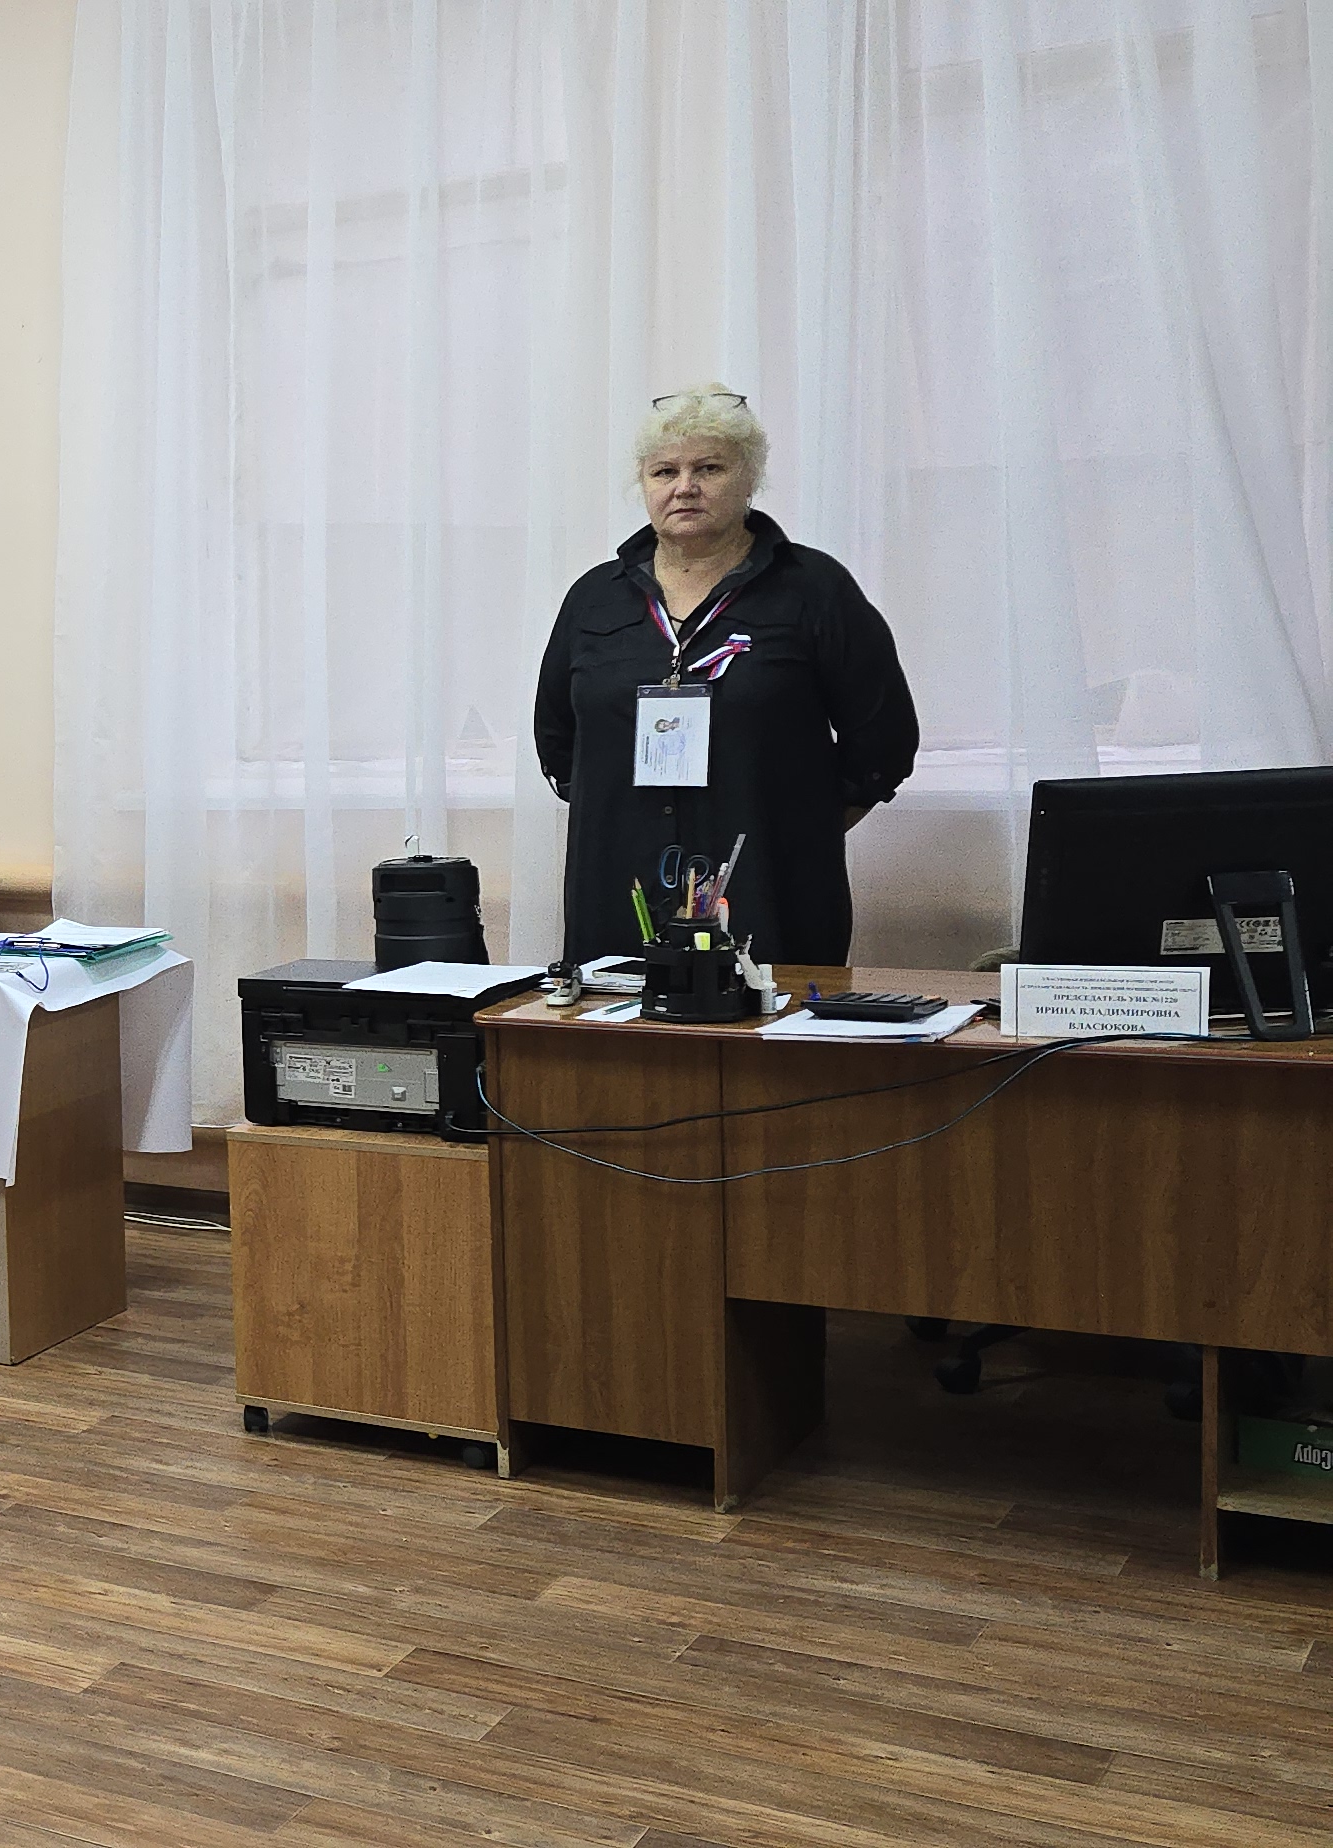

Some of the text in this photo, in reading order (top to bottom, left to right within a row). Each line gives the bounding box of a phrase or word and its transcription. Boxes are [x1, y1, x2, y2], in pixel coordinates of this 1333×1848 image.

[1035, 1006, 1181, 1019] ИРИНА ВЛАДИМИРОВНА
[1068, 1022, 1146, 1032] ВЛАСЮКОВА
[1294, 1443, 1333, 1470] Copy
